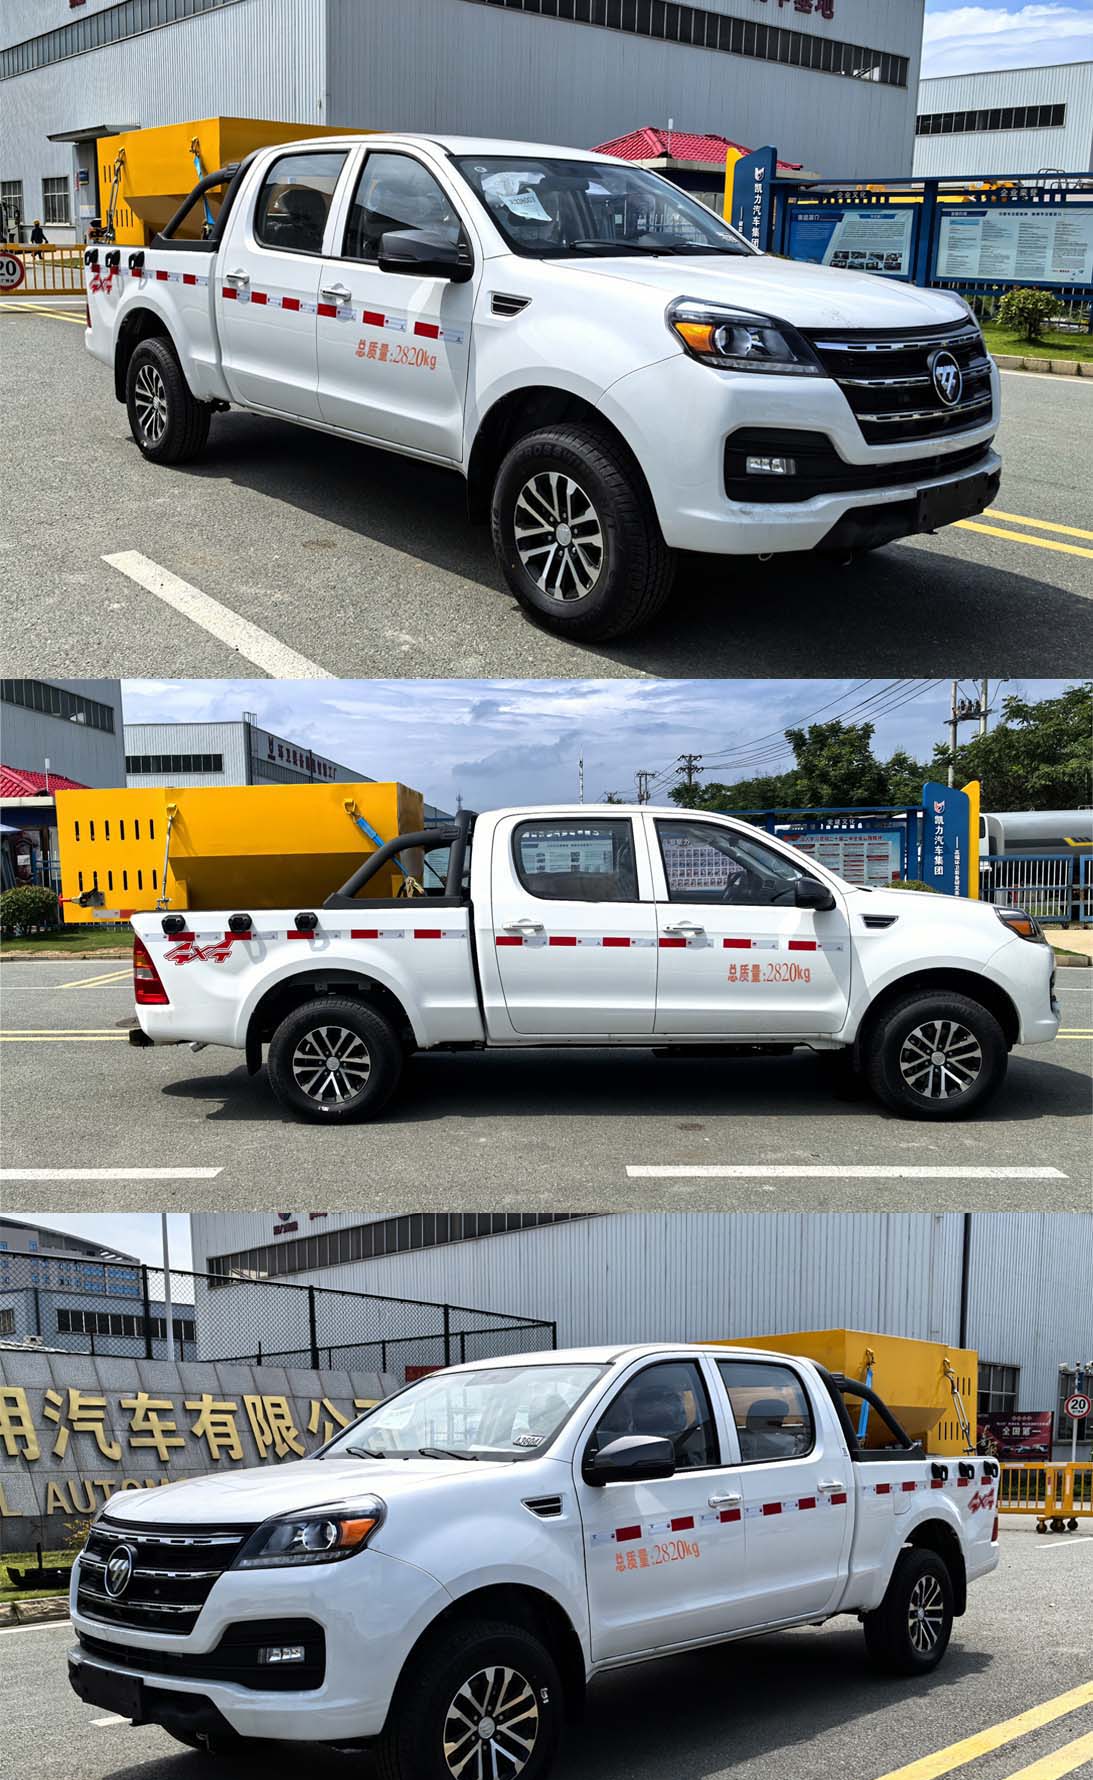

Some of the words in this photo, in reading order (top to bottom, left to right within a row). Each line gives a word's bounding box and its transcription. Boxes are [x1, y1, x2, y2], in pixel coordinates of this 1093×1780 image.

[933, 815, 945, 876] 凯力汽车集团
[1071, 1399, 1086, 1410] 20
